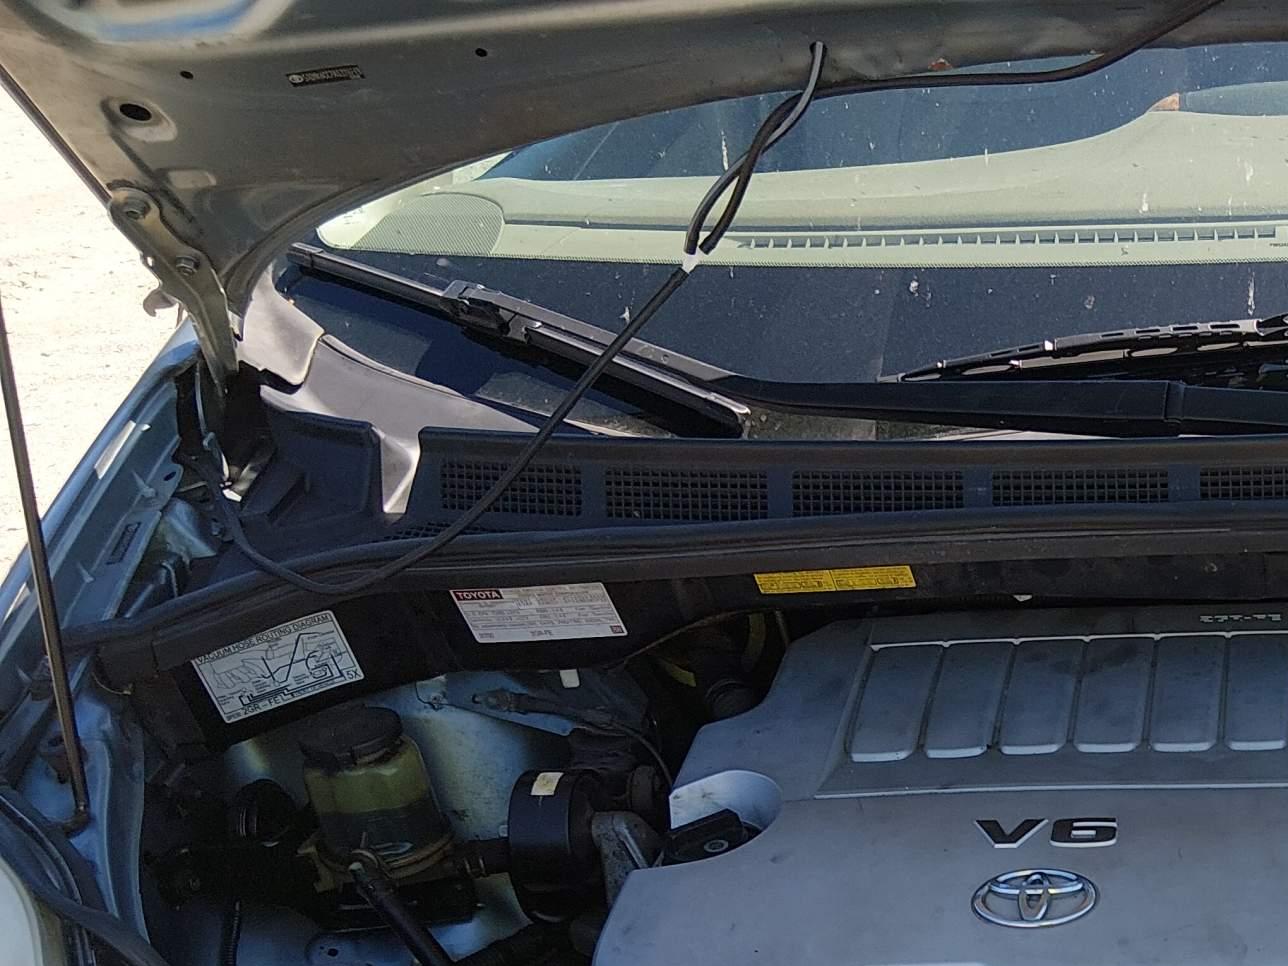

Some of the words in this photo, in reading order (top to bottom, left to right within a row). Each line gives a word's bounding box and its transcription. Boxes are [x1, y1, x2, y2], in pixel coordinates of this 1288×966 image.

[456, 590, 501, 600] TOYOTA
[198, 648, 233, 662] VACUUM
[230, 639, 256, 653] HOSE
[256, 625, 292, 643] ROUTING
[292, 615, 331, 630] DIAGRAM
[346, 669, 362, 680] 5X
[973, 817, 1118, 849] V6
